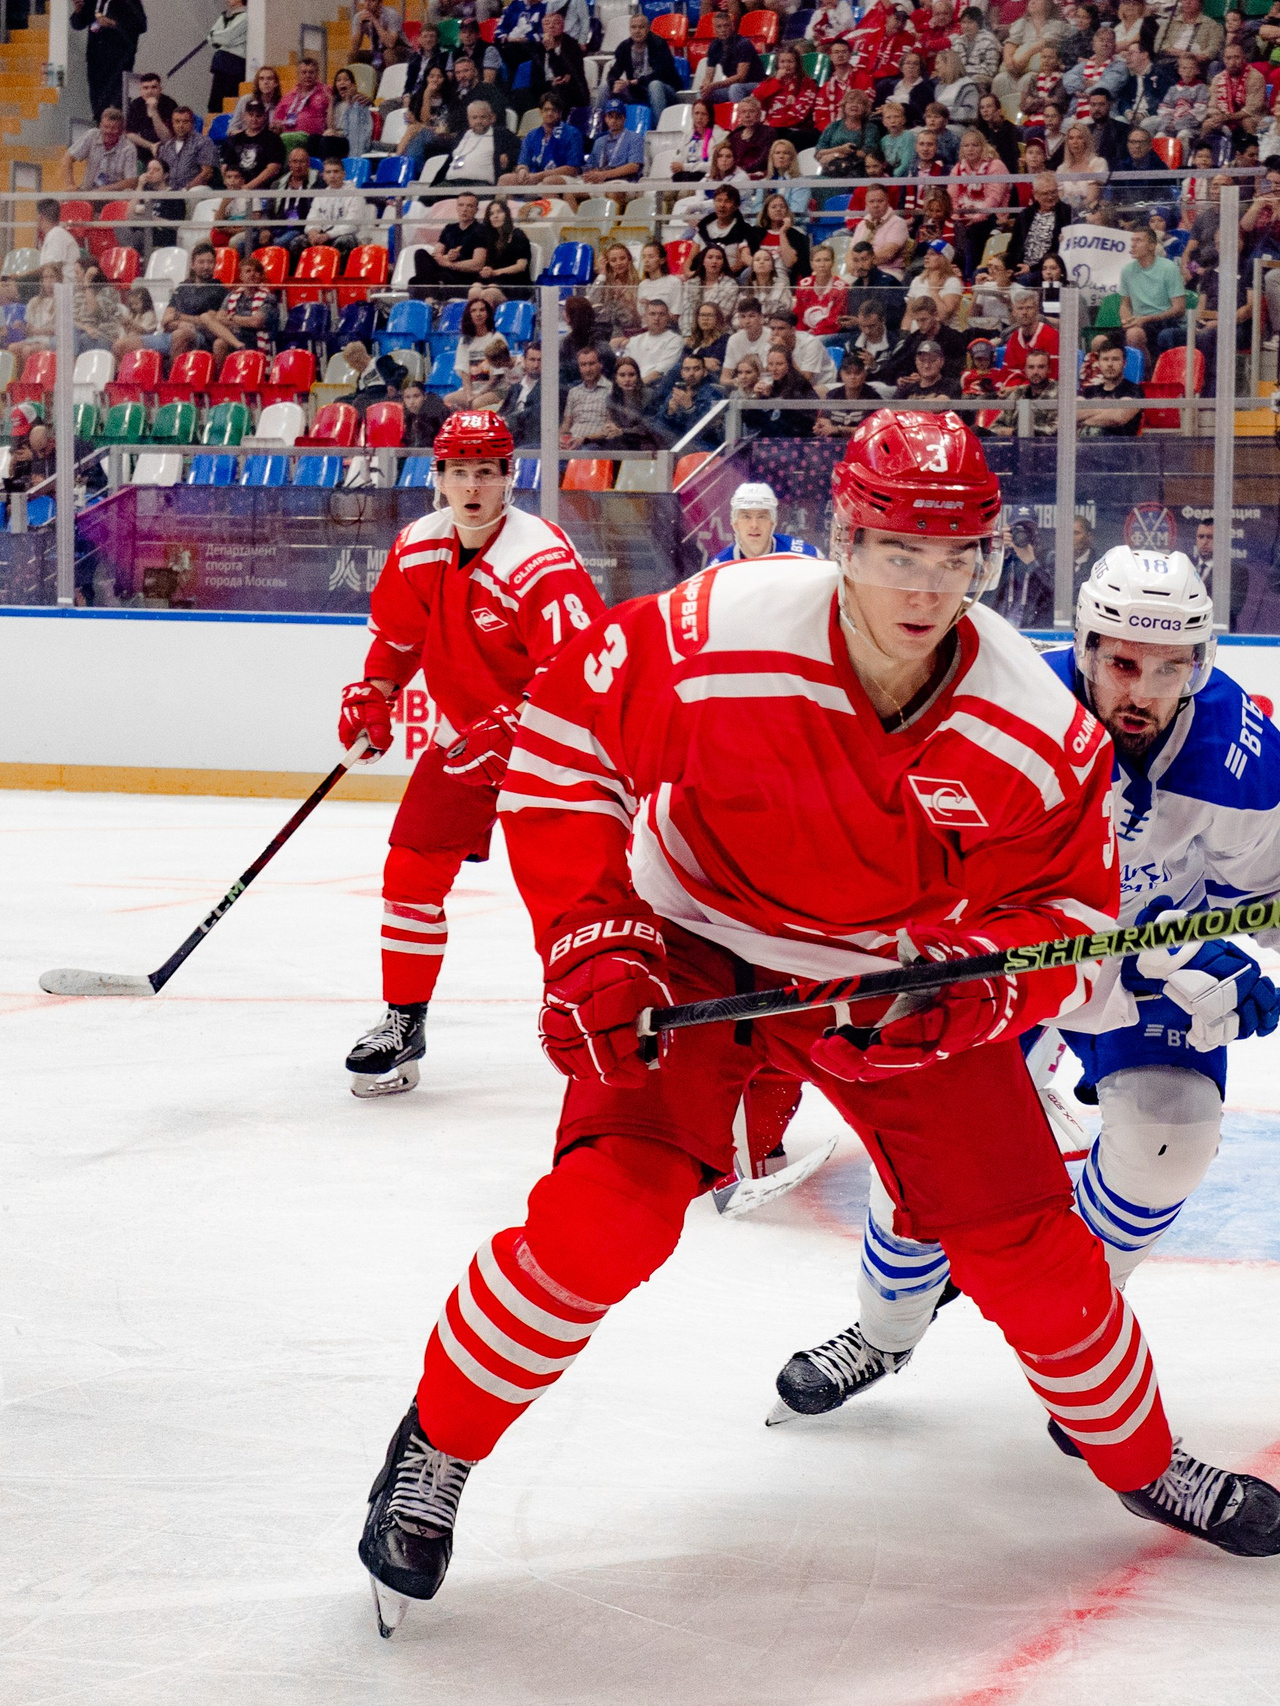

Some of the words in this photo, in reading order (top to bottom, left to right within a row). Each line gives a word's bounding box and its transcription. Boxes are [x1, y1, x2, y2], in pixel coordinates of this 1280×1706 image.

[460, 415, 482, 428] 78
[920, 444, 948, 473] 3
[1130, 529, 1168, 546] ФХМ
[513, 550, 567, 585] OLIMPBET
[1142, 558, 1168, 574] 18
[541, 593, 592, 645] 78
[584, 623, 628, 694] 3
